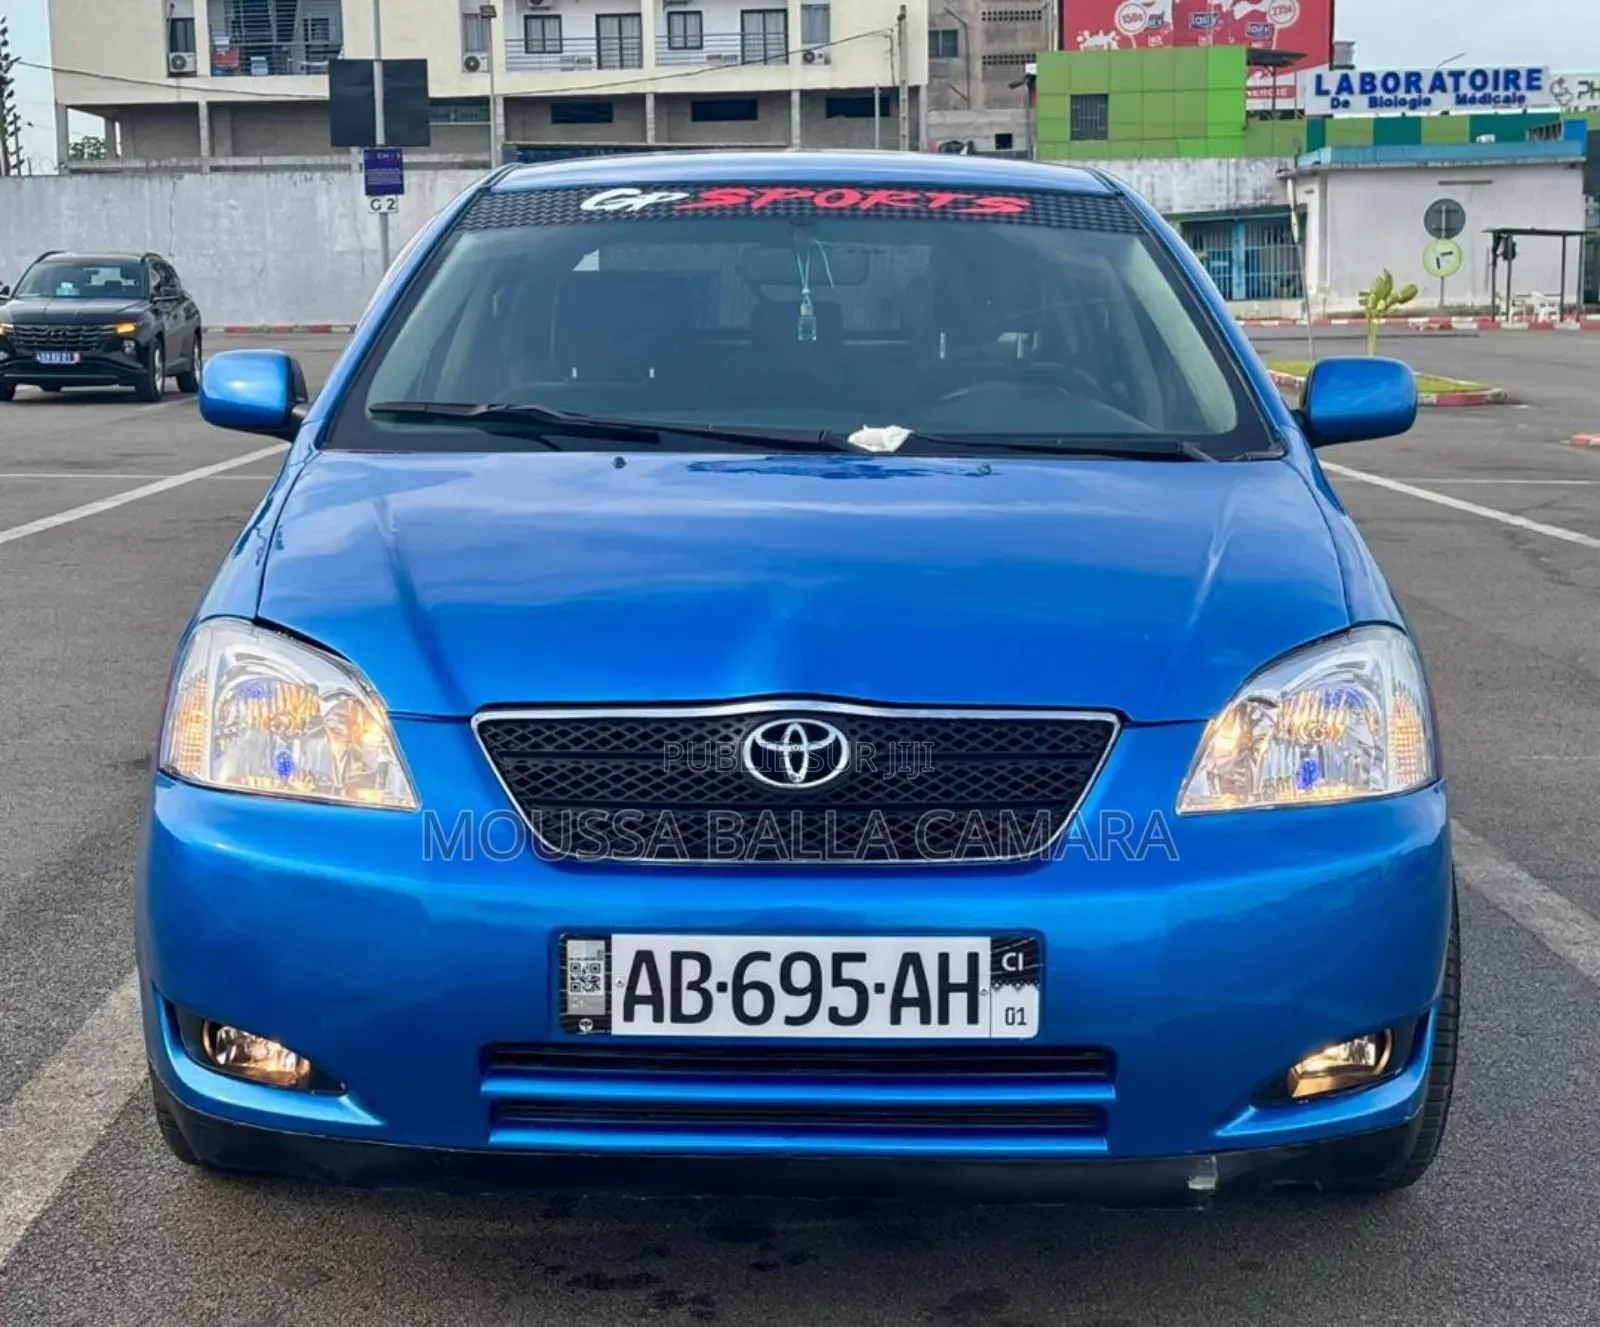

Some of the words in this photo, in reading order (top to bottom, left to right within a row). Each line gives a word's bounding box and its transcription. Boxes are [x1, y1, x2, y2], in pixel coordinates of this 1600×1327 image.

[1315, 69, 1543, 96] LABORATOIRE
[1330, 97, 1351, 109] De
[1368, 95, 1432, 110] Biologie
[1455, 92, 1526, 106] Médicale
[1001, 951, 1024, 972] CI
[1004, 1006, 1028, 1026] 01
